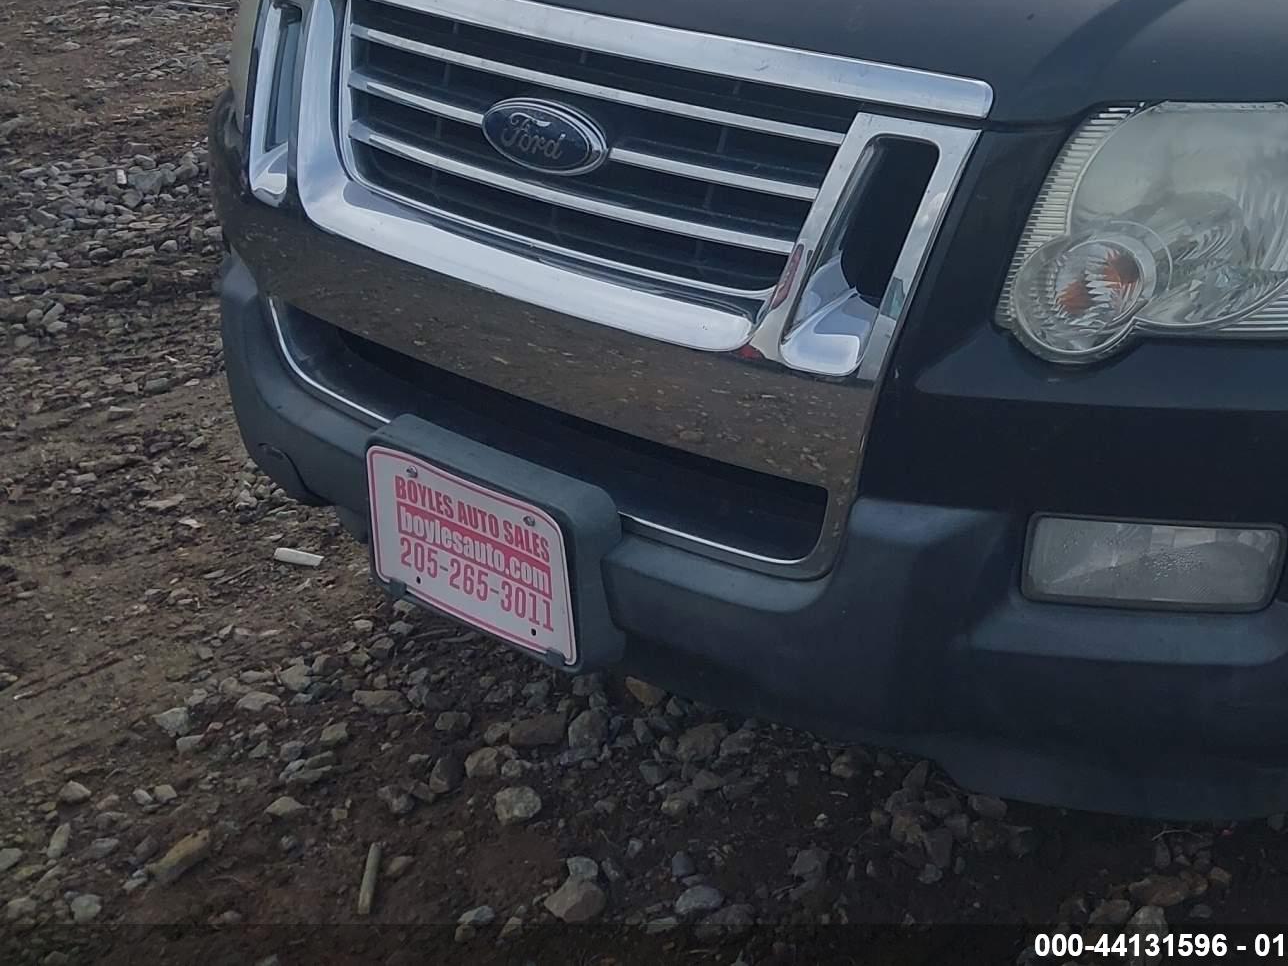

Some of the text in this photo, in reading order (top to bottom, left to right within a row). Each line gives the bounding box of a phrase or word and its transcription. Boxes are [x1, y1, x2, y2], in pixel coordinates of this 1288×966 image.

[501, 112, 567, 160] Ford
[395, 475, 550, 563] BOYLES AUTO SALES
[401, 509, 551, 595] boylesauto.com
[400, 537, 554, 632] 205-265-3011
